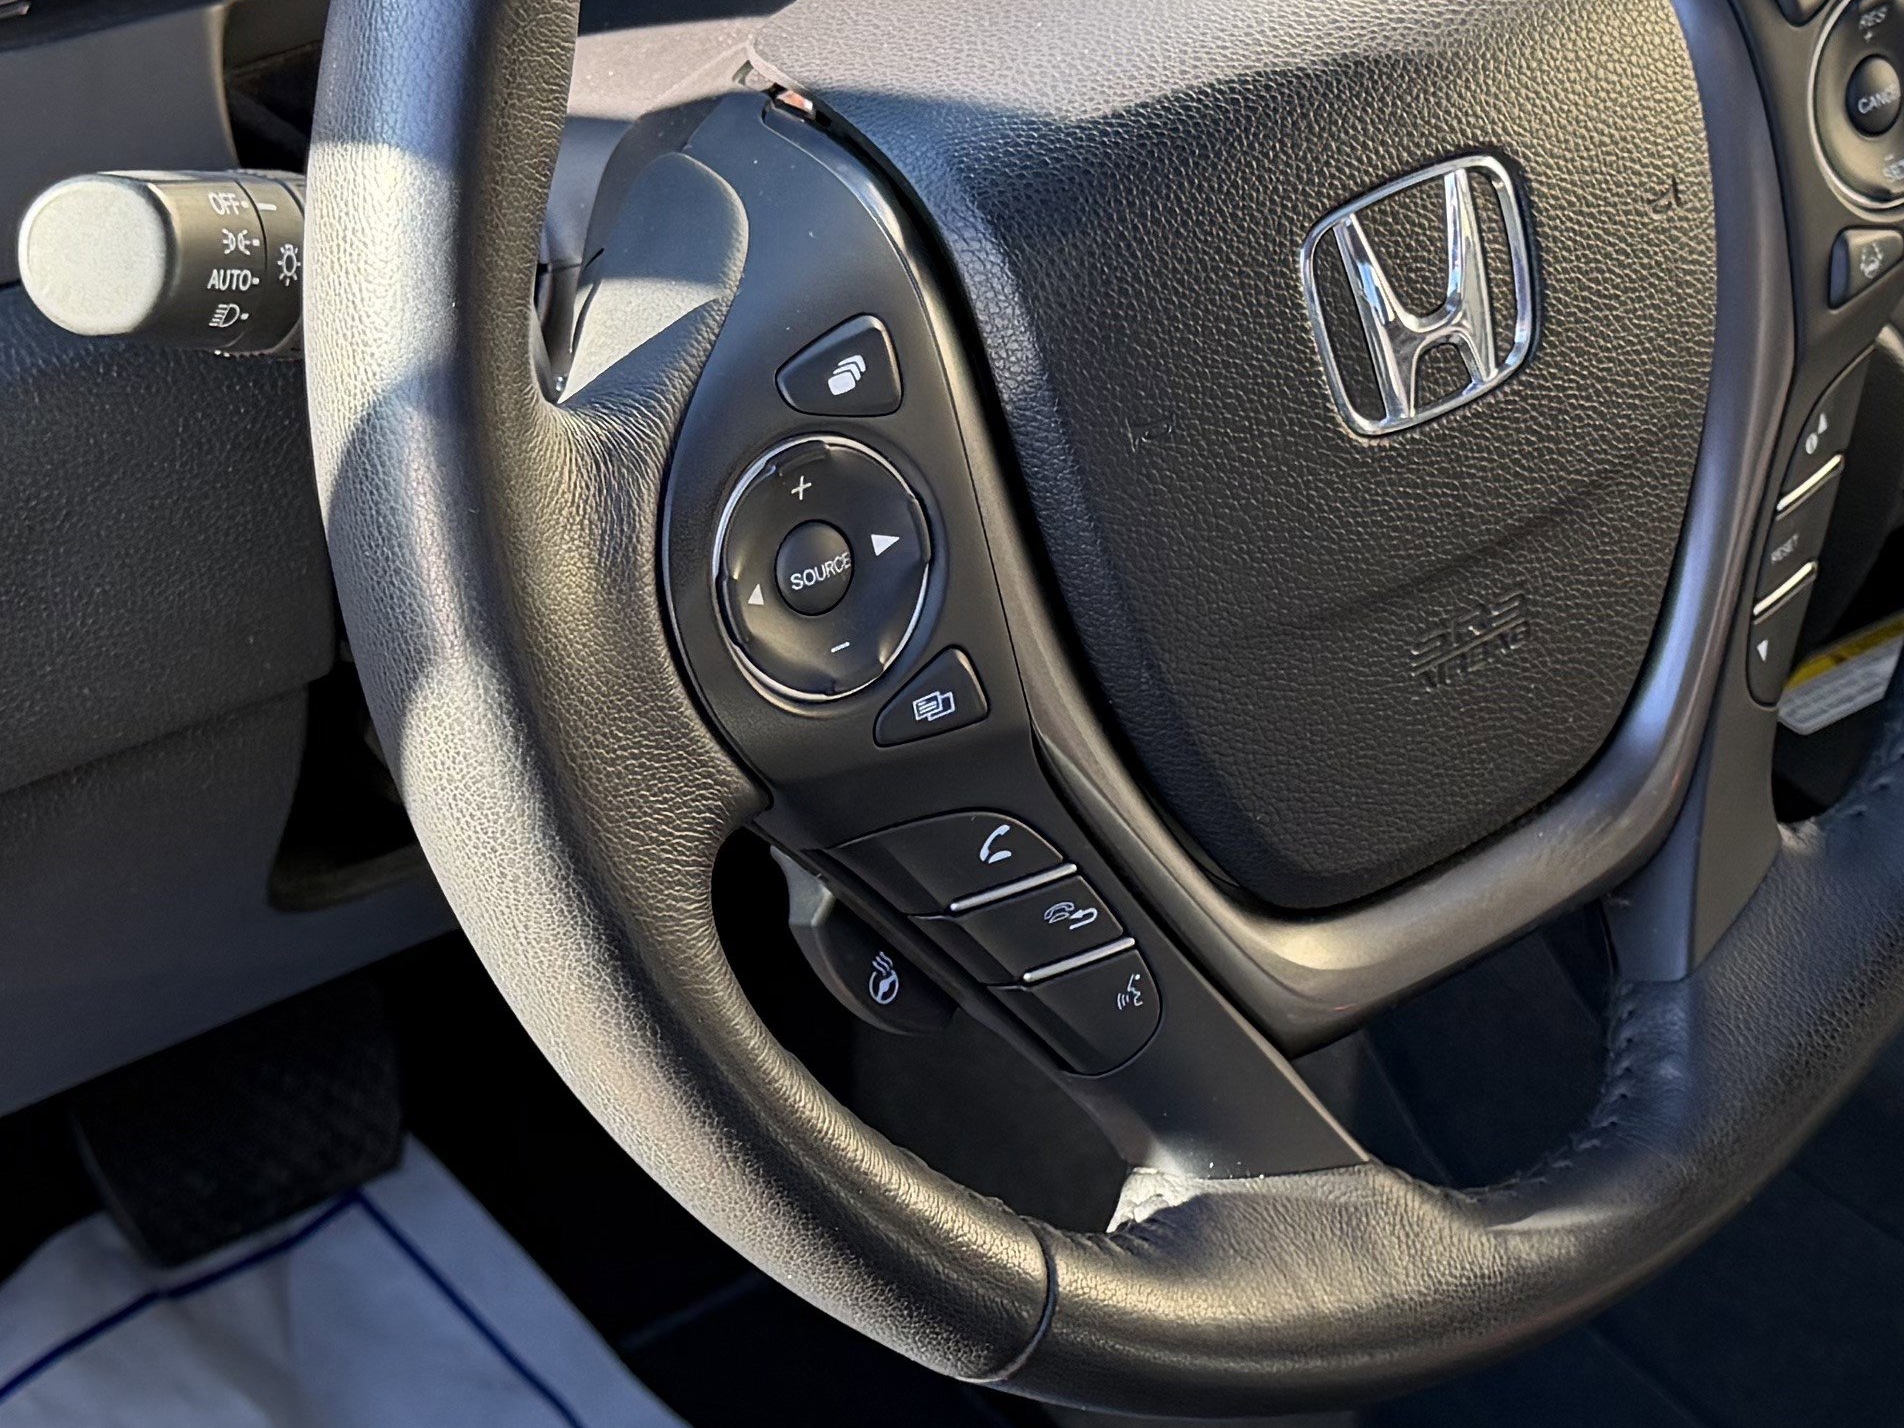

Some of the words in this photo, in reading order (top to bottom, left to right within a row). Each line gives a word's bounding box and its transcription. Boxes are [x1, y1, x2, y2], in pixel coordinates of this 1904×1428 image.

[208, 191, 240, 216] OFF
[207, 269, 252, 291] AUTO
[790, 551, 852, 591] SOURCE
